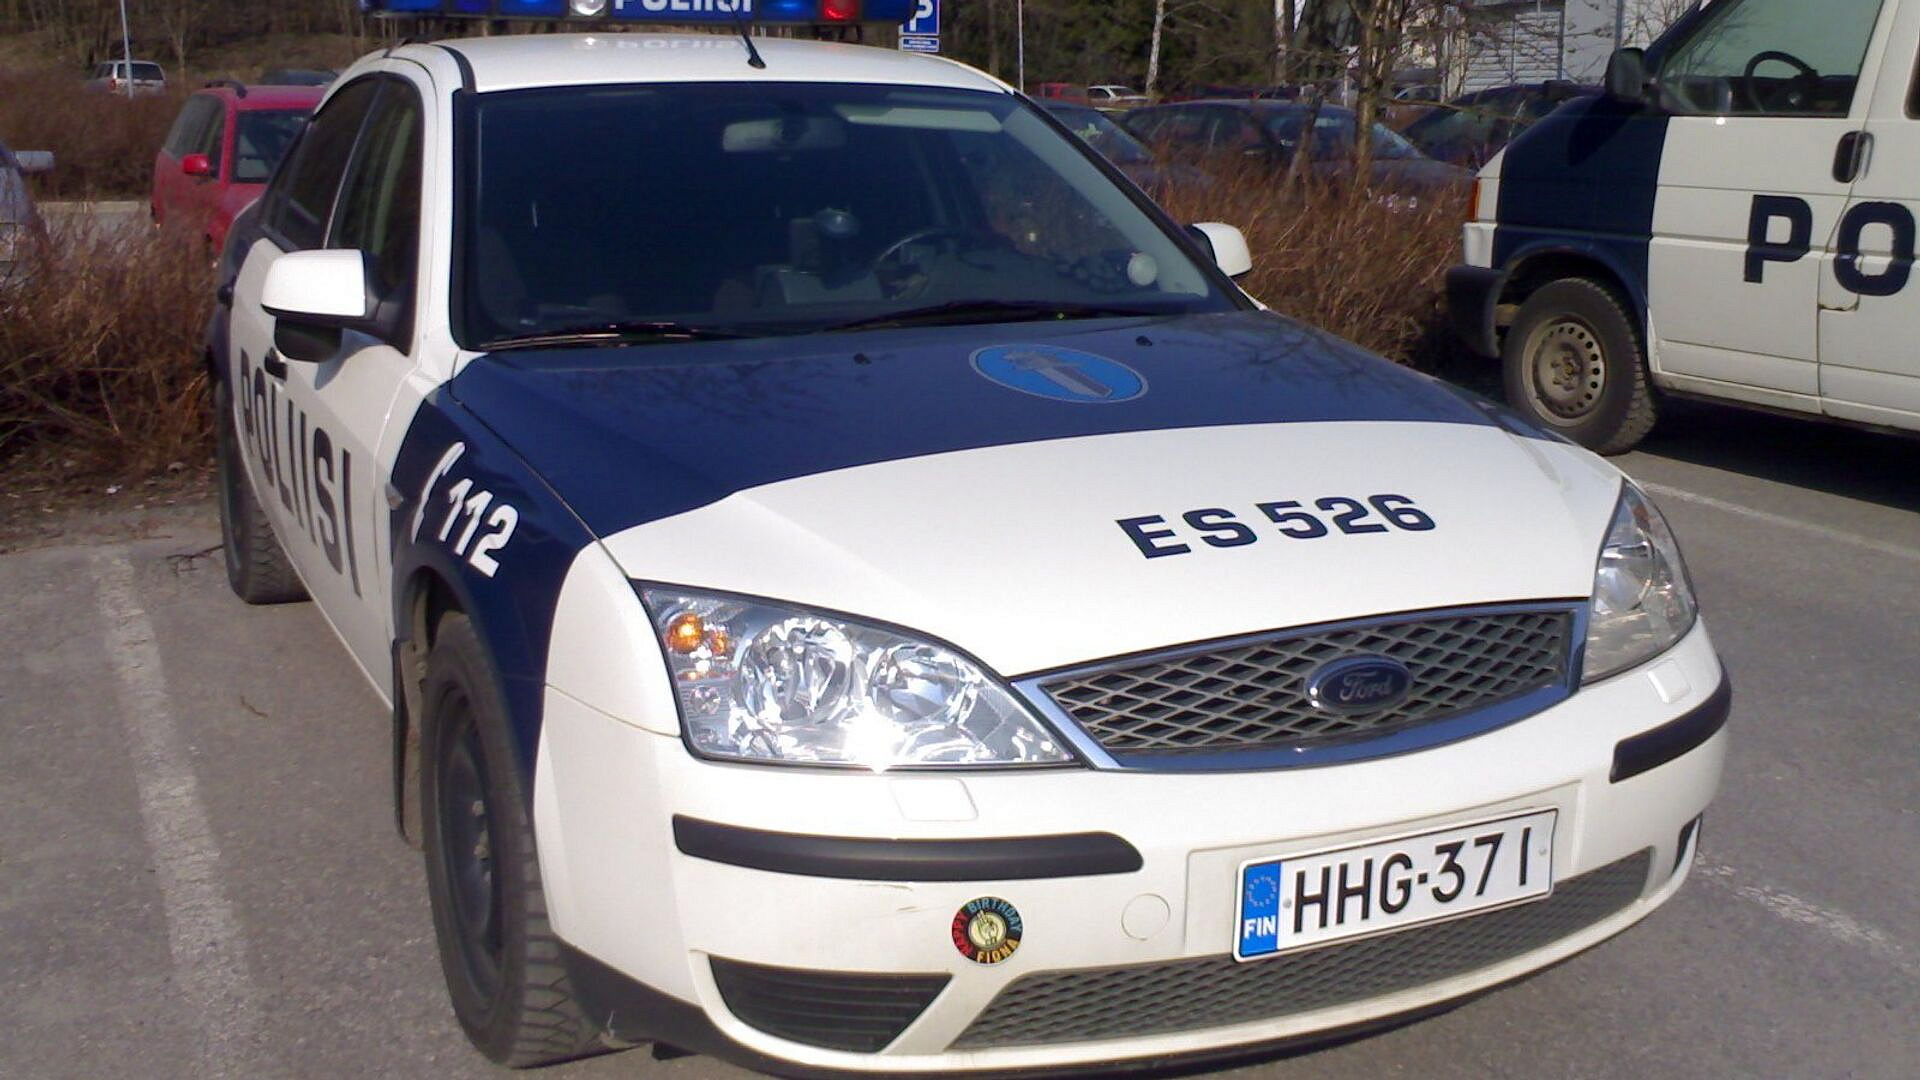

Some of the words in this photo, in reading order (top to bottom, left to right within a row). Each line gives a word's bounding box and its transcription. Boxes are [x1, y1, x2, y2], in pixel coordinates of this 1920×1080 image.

[1744, 194, 1916, 297] PO
[438, 478, 519, 578] 112
[1115, 506, 1258, 560] ES
[1255, 494, 1436, 540] 526
[1340, 670, 1393, 700] Ford
[1294, 827, 1532, 934] HHG-371
[1243, 915, 1276, 939] FIN
